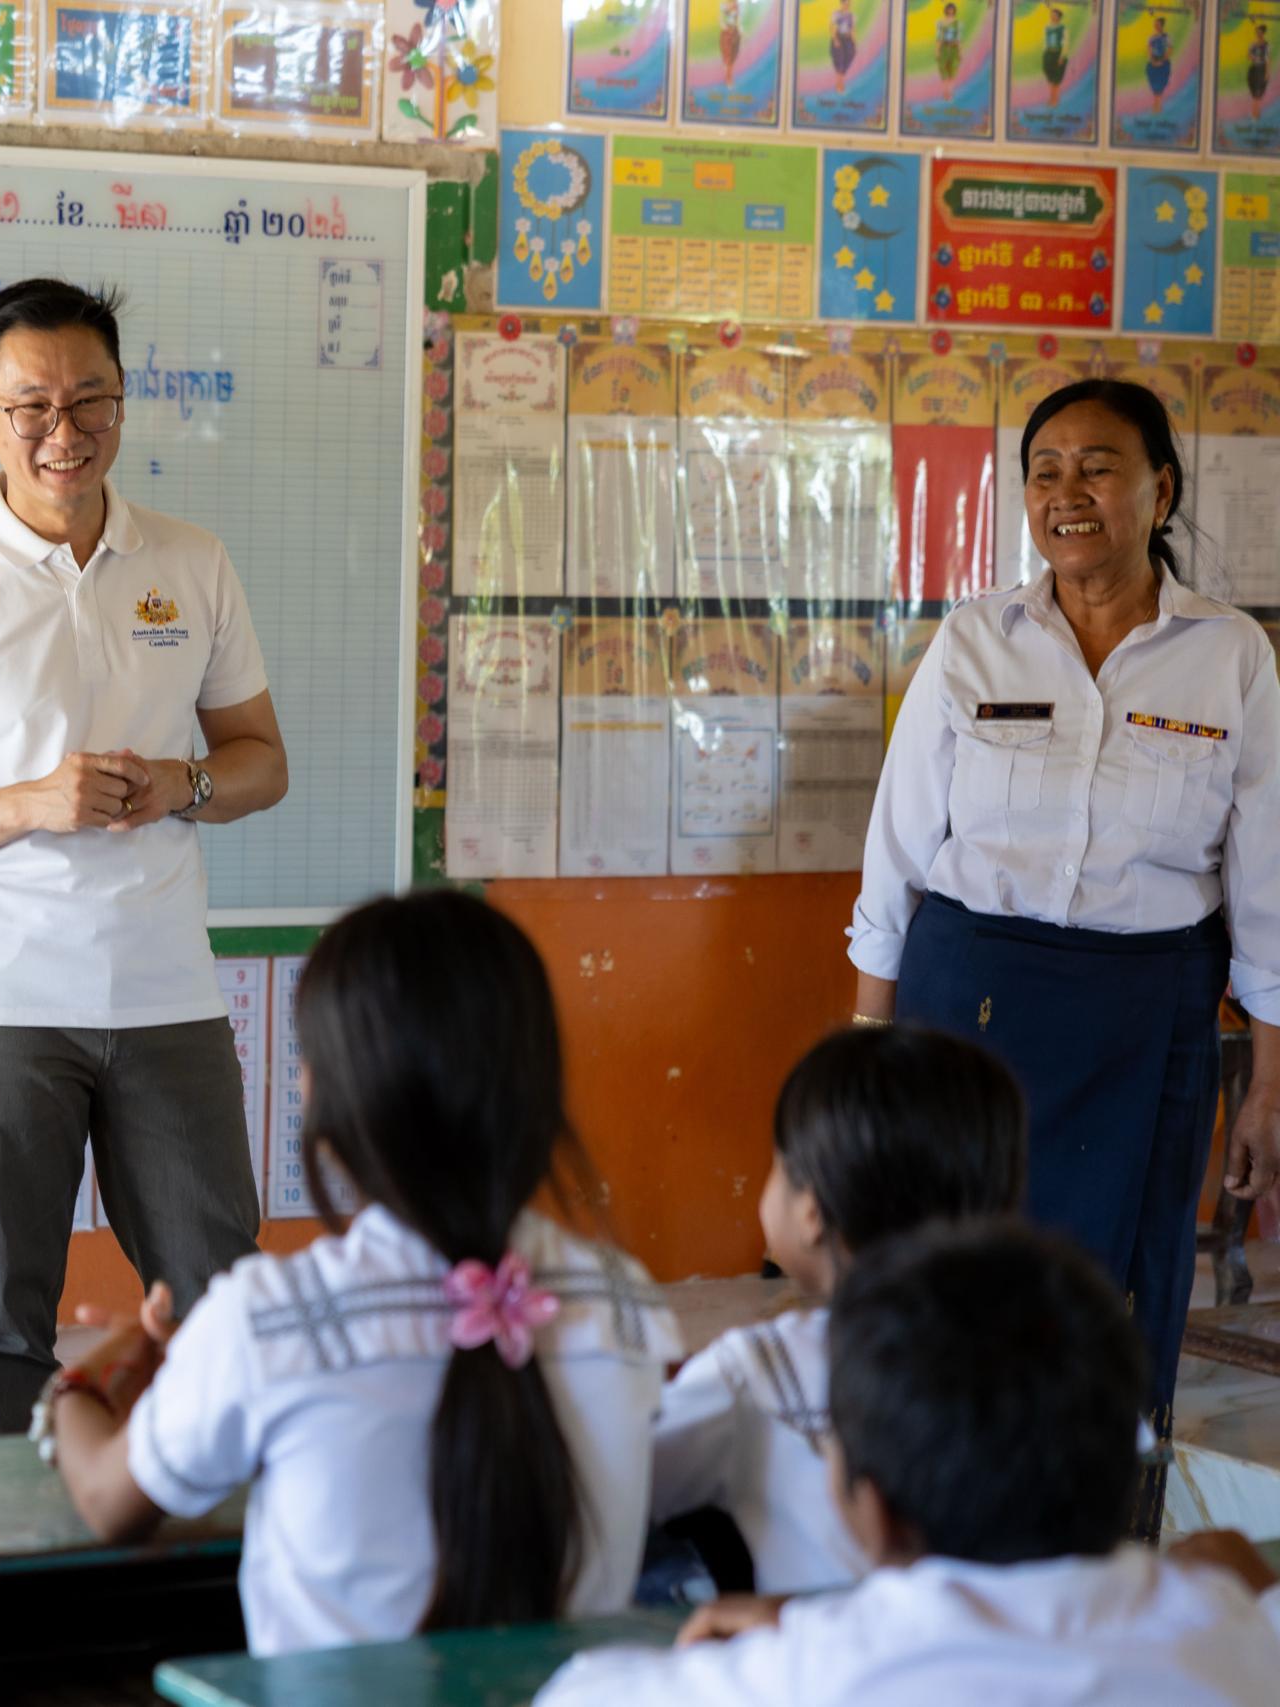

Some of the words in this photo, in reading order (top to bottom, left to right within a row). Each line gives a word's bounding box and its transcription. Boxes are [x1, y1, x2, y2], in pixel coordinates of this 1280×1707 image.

[56, 190, 84, 227] ខែ
[235, 970, 246, 984] 9
[233, 995, 249, 1009] 18
